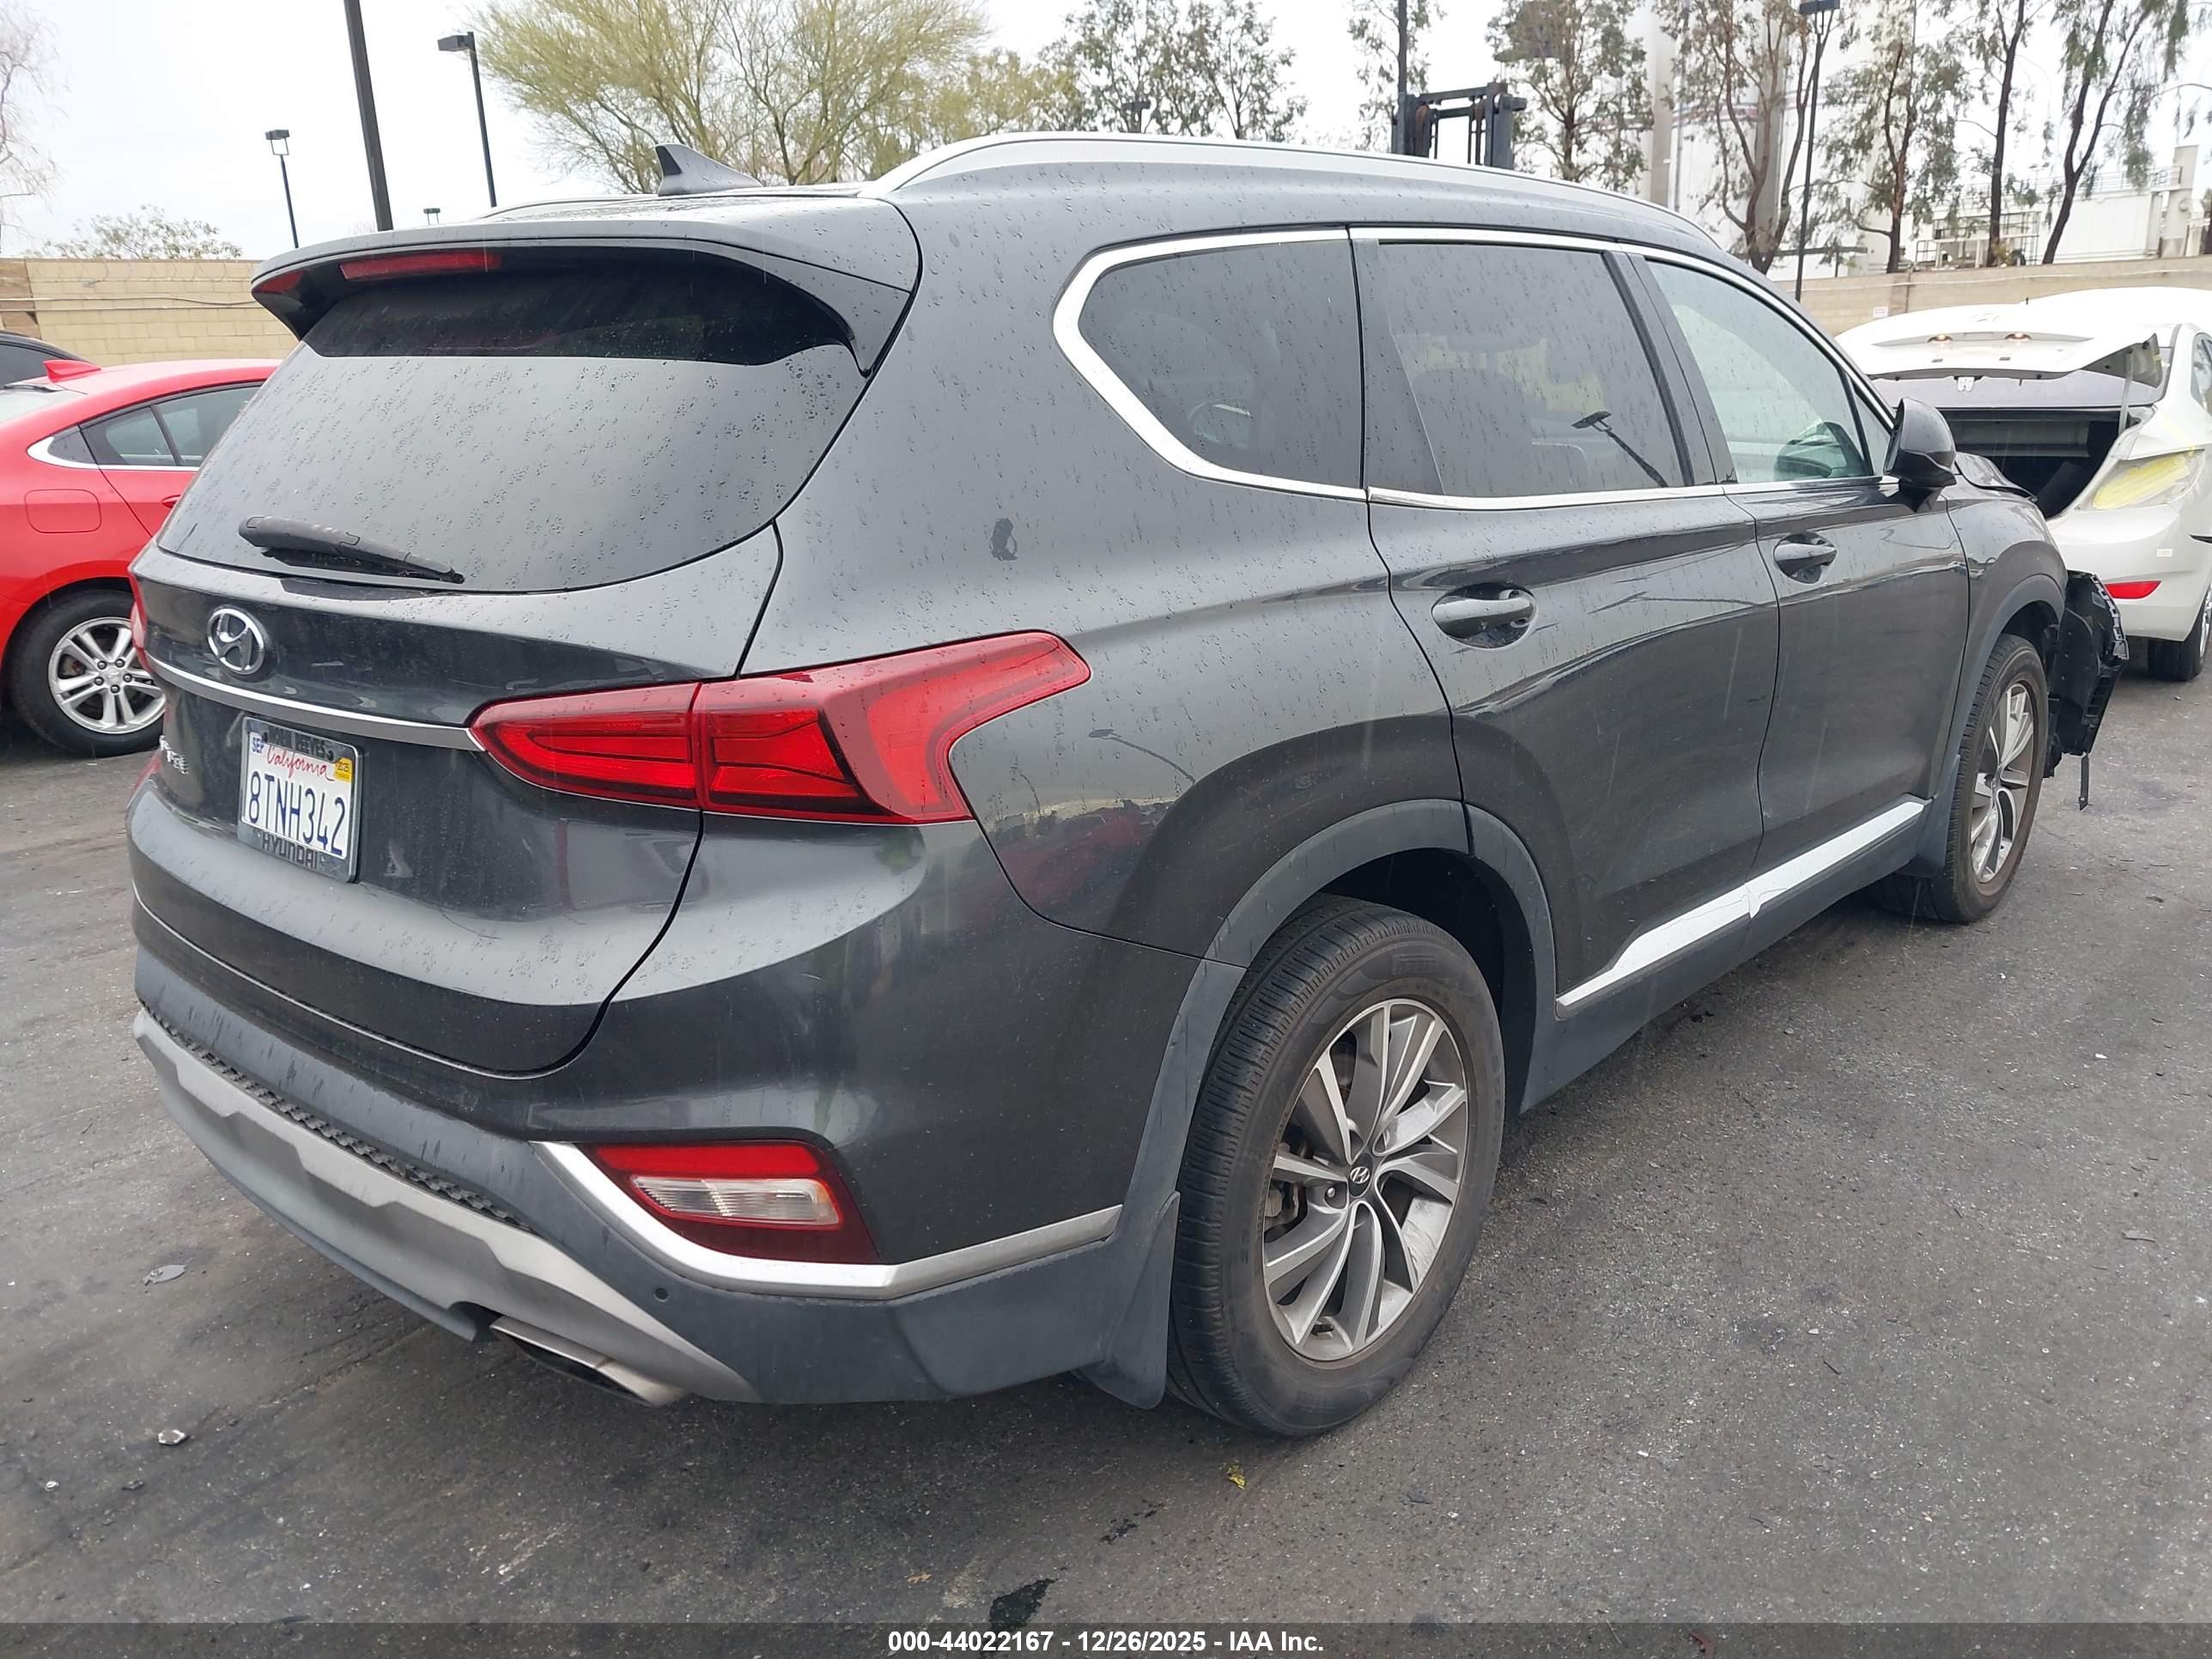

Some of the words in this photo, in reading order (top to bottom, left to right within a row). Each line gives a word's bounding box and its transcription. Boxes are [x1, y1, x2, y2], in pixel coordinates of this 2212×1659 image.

[265, 744, 336, 781] California
[249, 771, 345, 856] 8TNH342
[262, 830, 317, 870] HYUNDAI
